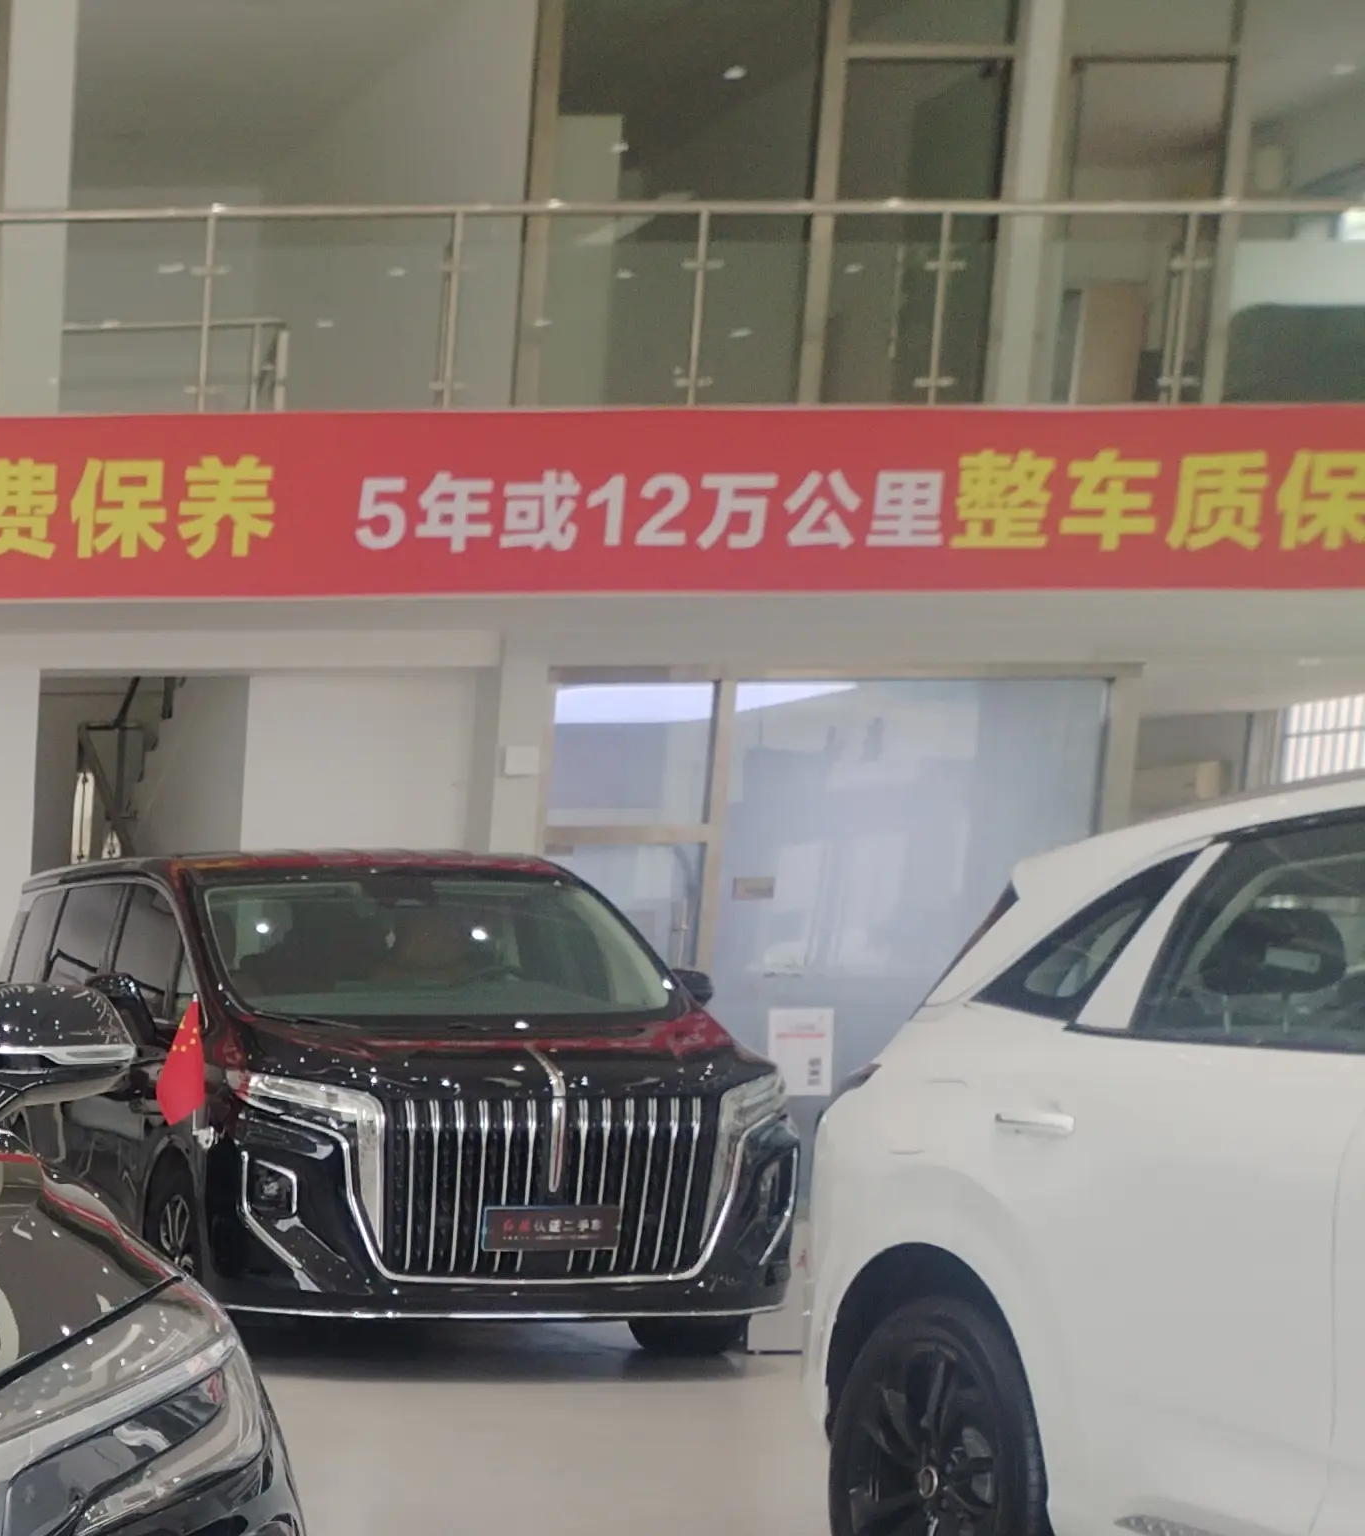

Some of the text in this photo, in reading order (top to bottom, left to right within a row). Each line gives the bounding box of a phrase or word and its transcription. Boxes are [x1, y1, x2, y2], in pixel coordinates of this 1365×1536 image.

[355, 448, 1365, 554] 5年或12万公里整车质保
